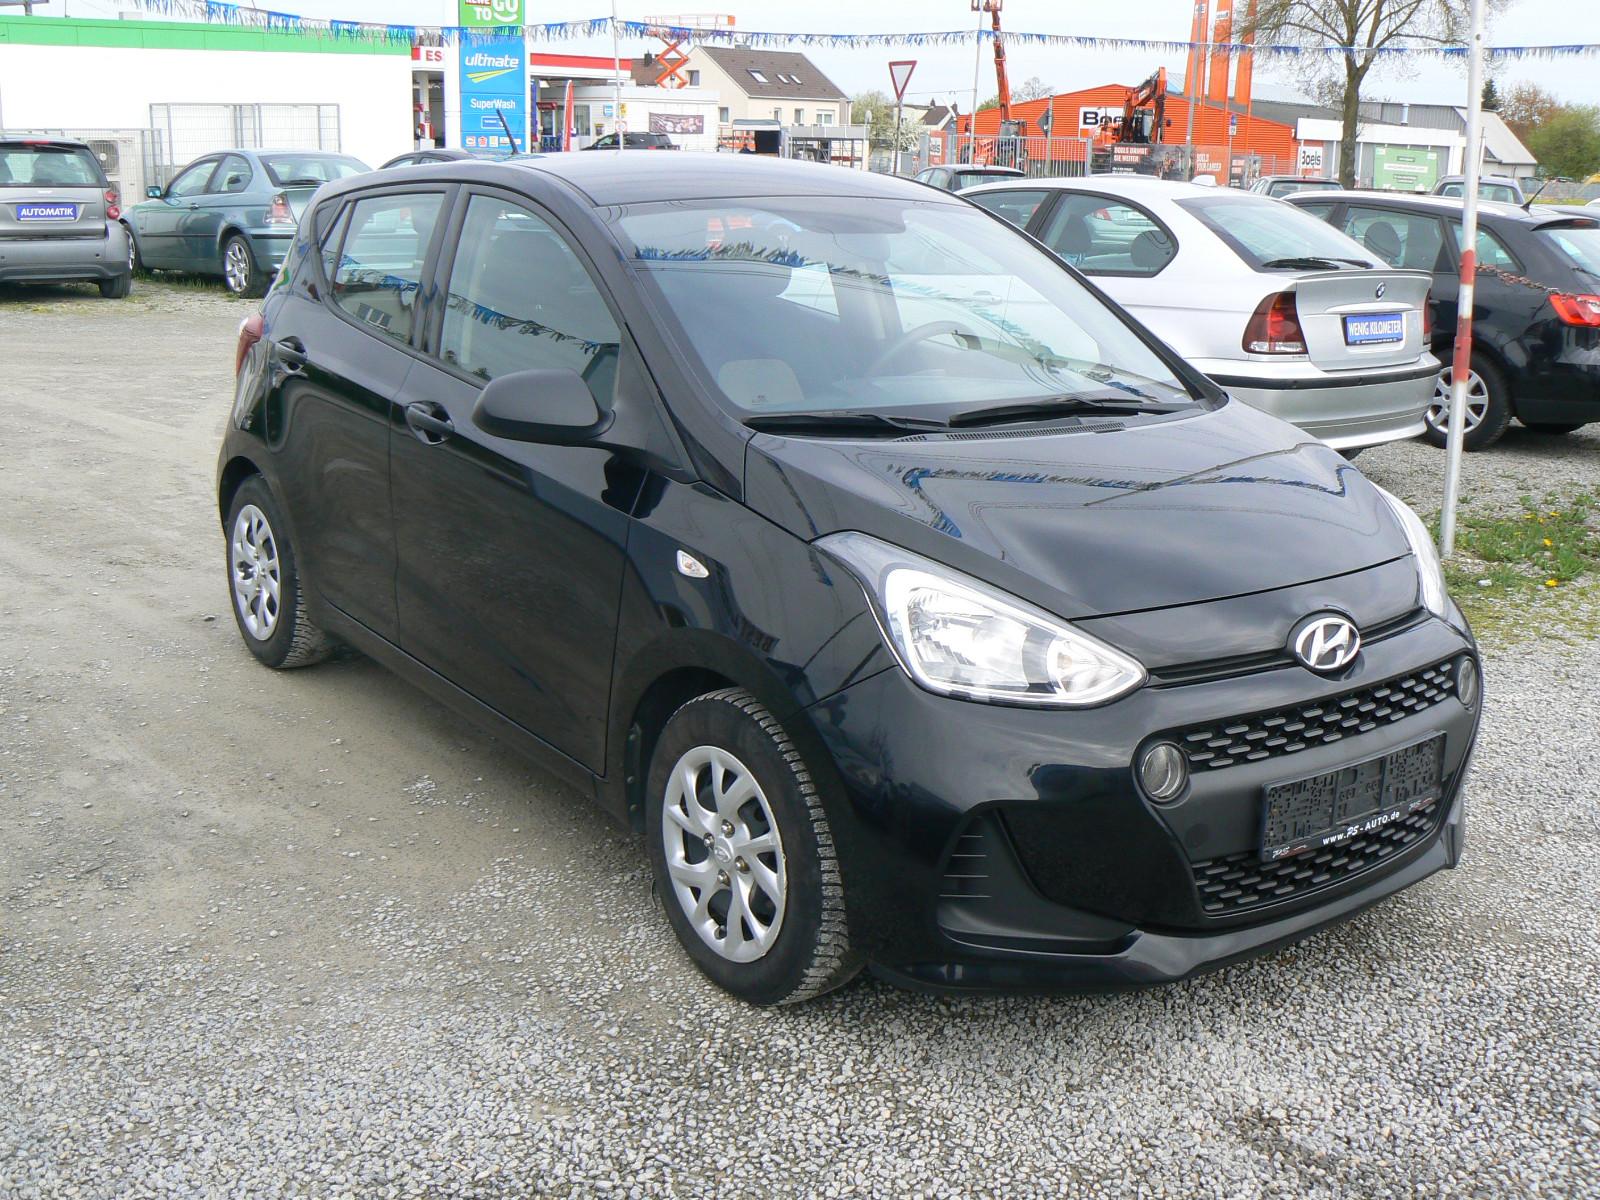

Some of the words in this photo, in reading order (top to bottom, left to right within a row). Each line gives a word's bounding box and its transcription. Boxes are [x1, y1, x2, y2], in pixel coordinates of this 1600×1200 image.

[473, 7, 492, 21] TO
[425, 51, 444, 62] ES
[465, 53, 520, 68] ultimate
[470, 98, 516, 110] SuperWash
[20, 207, 74, 217] AUTOMATIK
[1348, 321, 1369, 336] WENIG
[1370, 320, 1402, 335] KILOMETER
